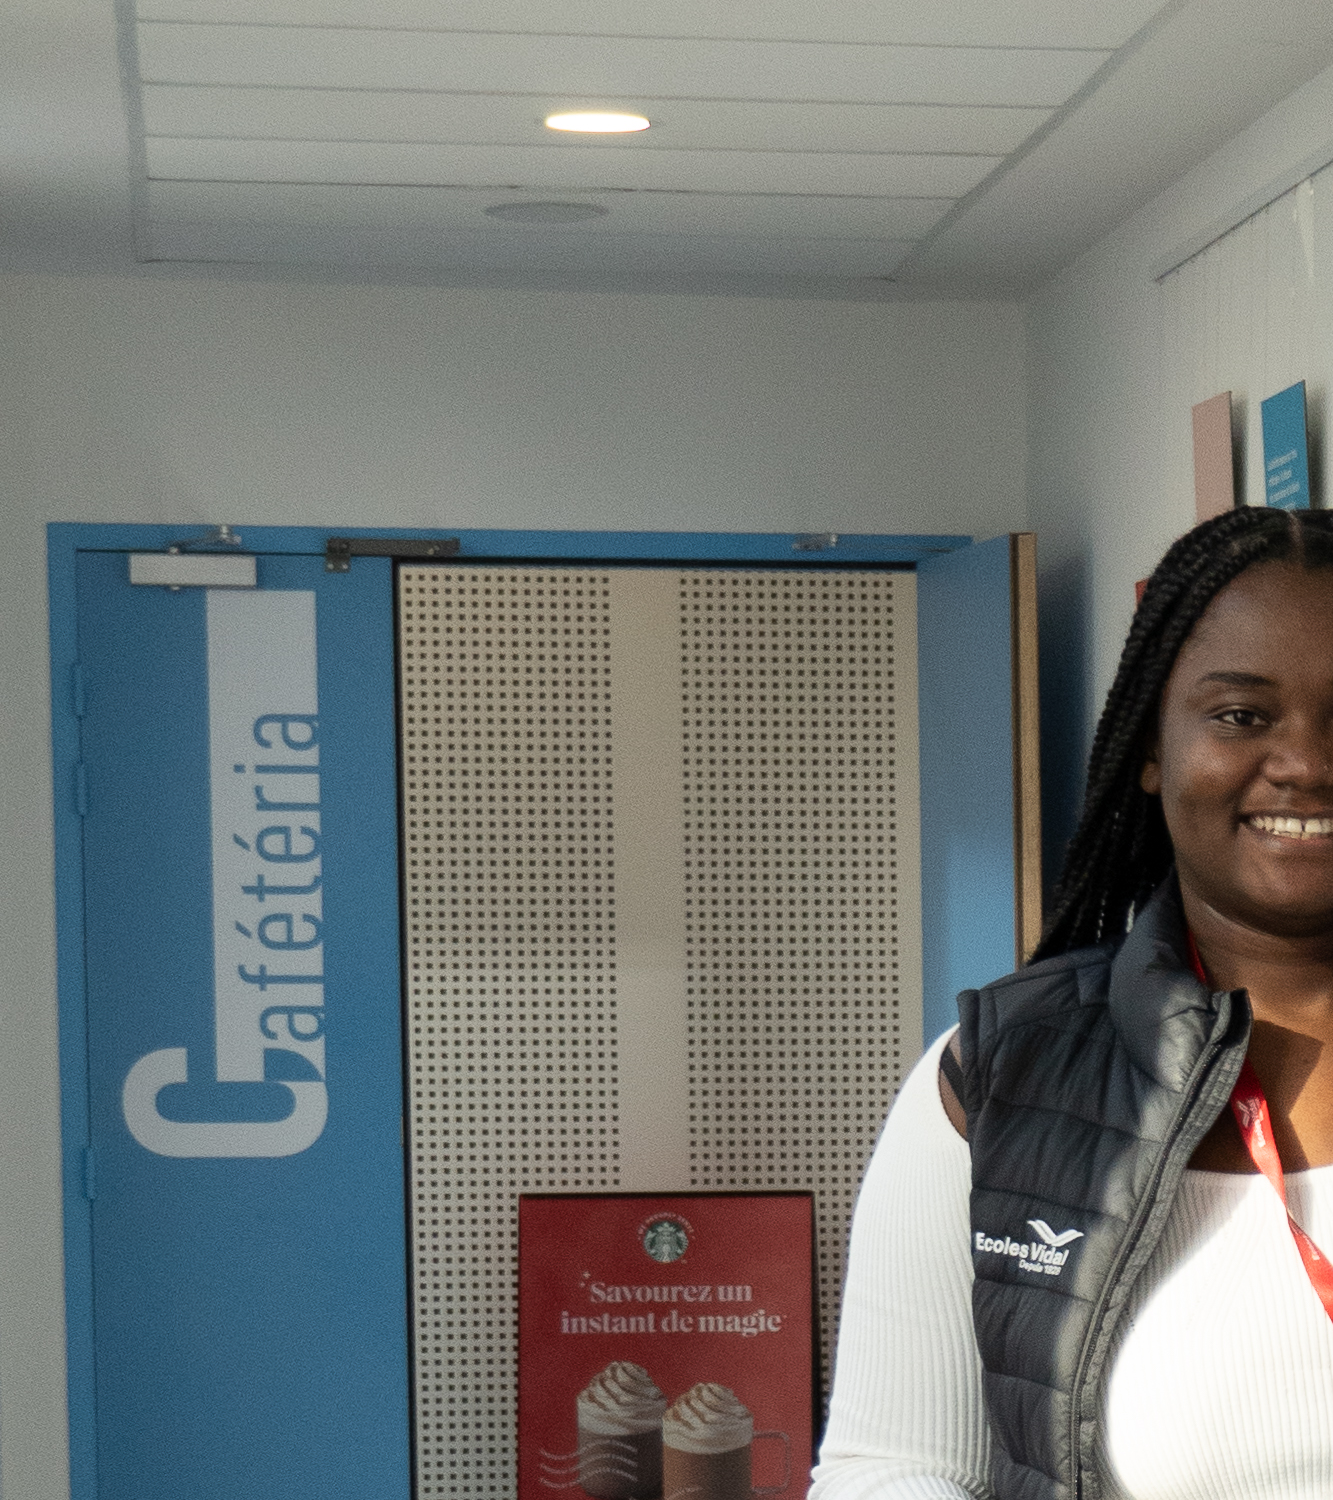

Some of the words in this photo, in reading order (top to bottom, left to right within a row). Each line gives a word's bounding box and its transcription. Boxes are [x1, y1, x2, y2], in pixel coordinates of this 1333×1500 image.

[122, 711, 329, 1159] Cafétéria
[975, 1232, 1029, 1259] Ecoles
[1030, 1242, 1069, 1266] Vidal
[590, 1281, 712, 1303] Savourez
[717, 1284, 753, 1302] un
[561, 1310, 657, 1334] instant
[661, 1310, 693, 1333] de
[699, 1309, 782, 1337] magie
